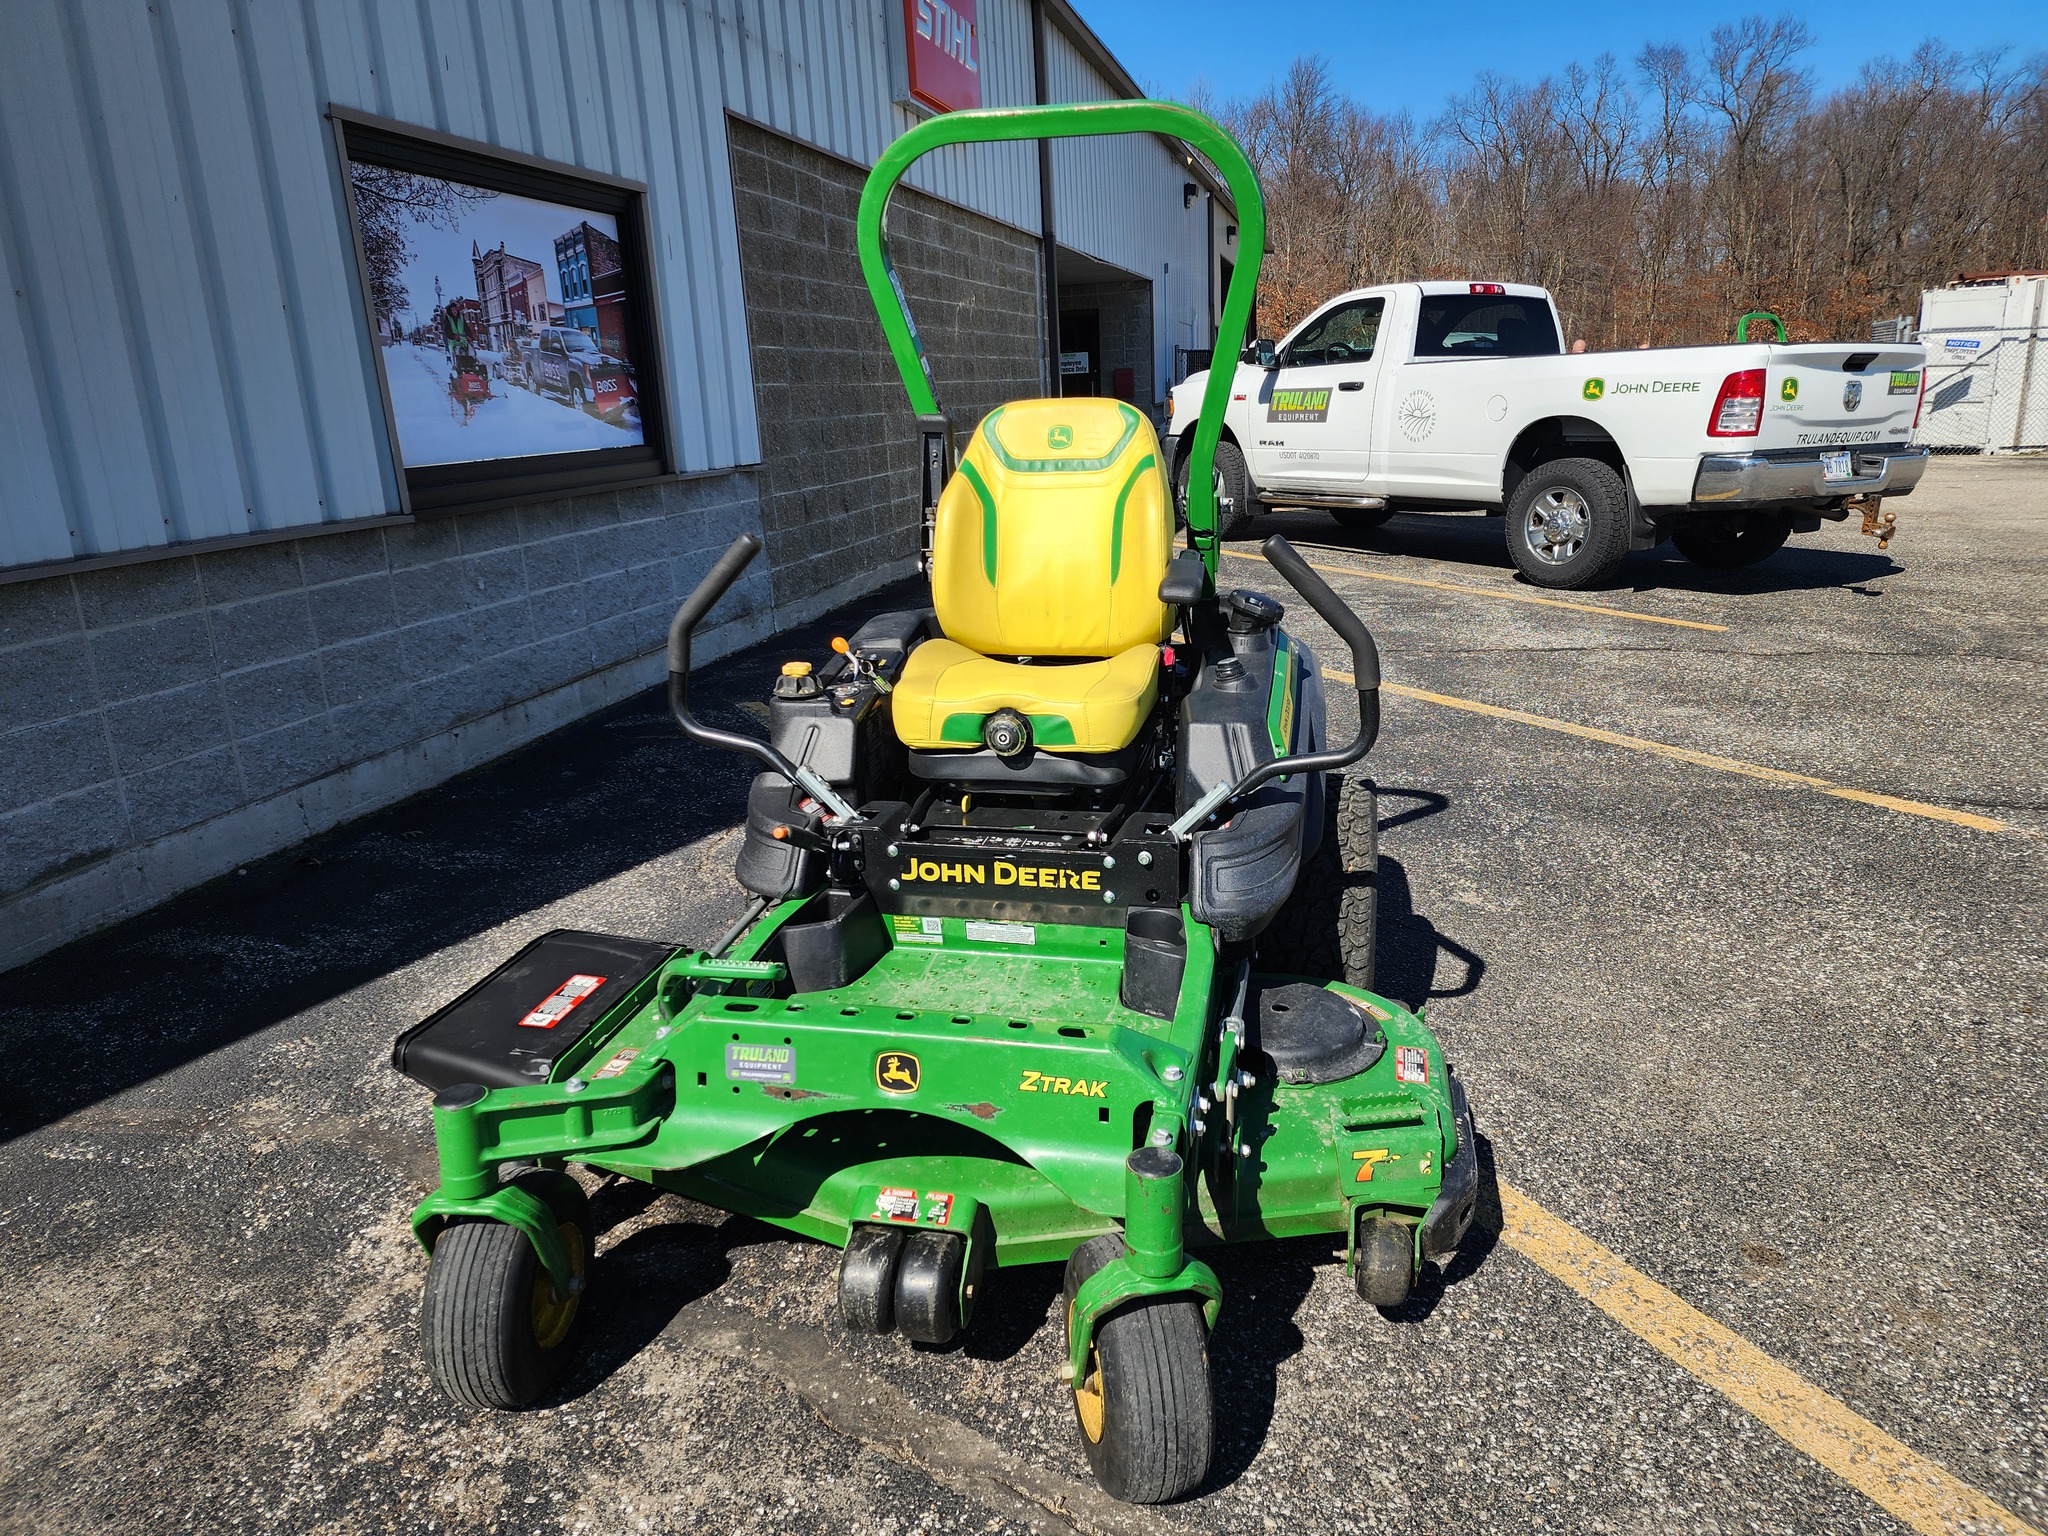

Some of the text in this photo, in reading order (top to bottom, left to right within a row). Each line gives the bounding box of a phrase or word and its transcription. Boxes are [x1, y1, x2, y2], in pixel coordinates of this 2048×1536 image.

[916, 0, 978, 75] STIHL
[543, 362, 561, 380] BOSS
[1061, 360, 1082, 368] mployee
[468, 381, 481, 389] BOSS
[596, 379, 618, 394] BOSS
[1890, 371, 1920, 387] TRULAND
[1611, 381, 1701, 395] JOHN DEERE
[1271, 390, 1329, 411] TRULAND
[1770, 403, 1804, 412] JOHN DEERE
[1278, 413, 1319, 421] EQUIPMENT
[1796, 430, 1881, 445] TRULANDEQUIP.COM
[1279, 452, 1297, 460] USDOT
[901, 857, 1101, 891] JOHN DEERE
[732, 1046, 790, 1064] TRULAND
[739, 1061, 783, 1070] EQUIPMENT
[1018, 1069, 1110, 1099] ZTRAK
